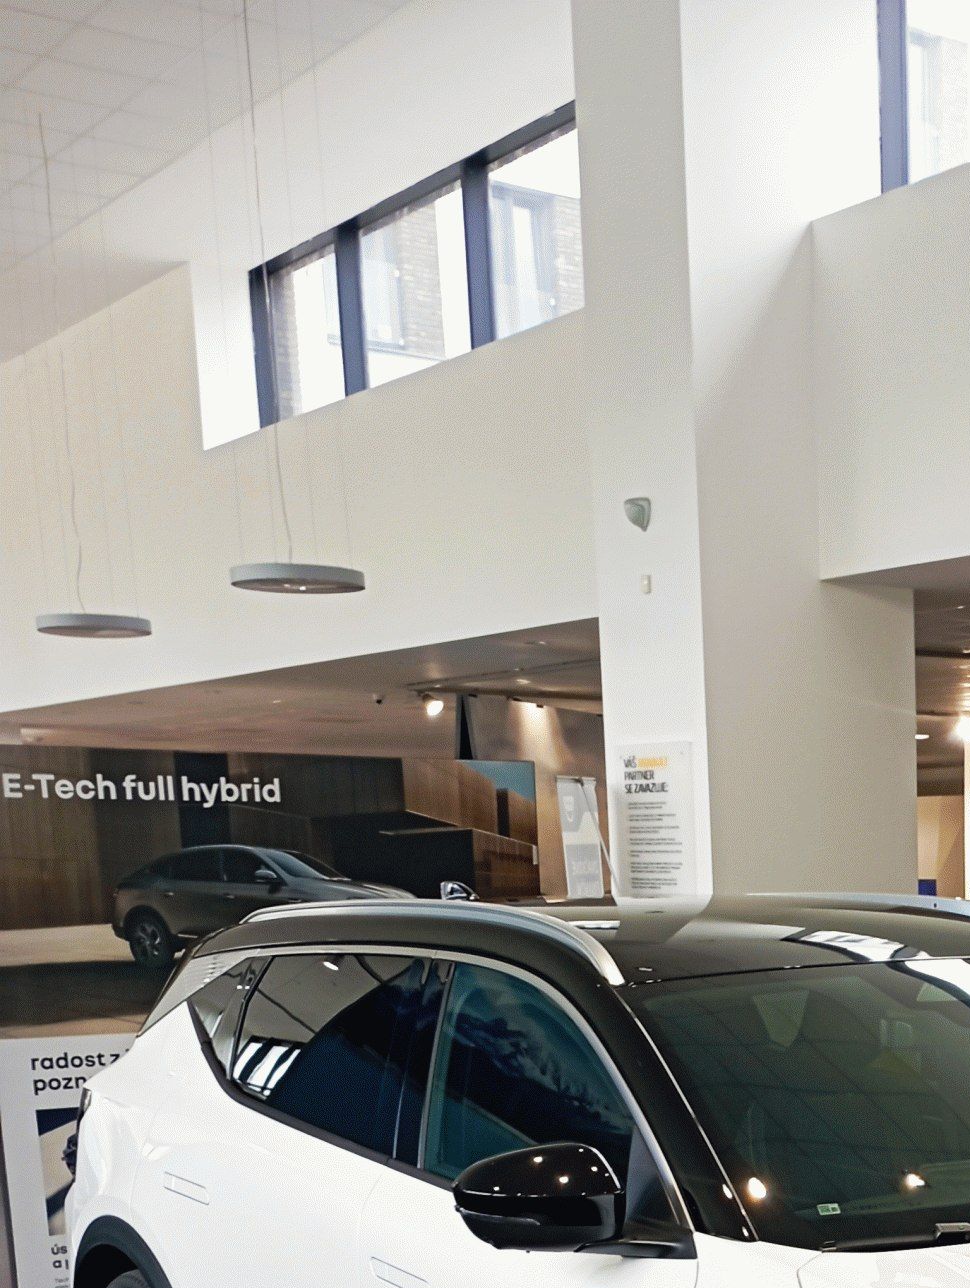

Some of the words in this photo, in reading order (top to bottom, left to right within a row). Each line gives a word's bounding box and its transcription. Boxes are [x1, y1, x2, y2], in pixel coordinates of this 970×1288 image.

[2, 773, 118, 799] E-Tech
[122, 774, 175, 801] full
[181, 775, 282, 808] hybrid
[31, 1052, 106, 1070] radost
